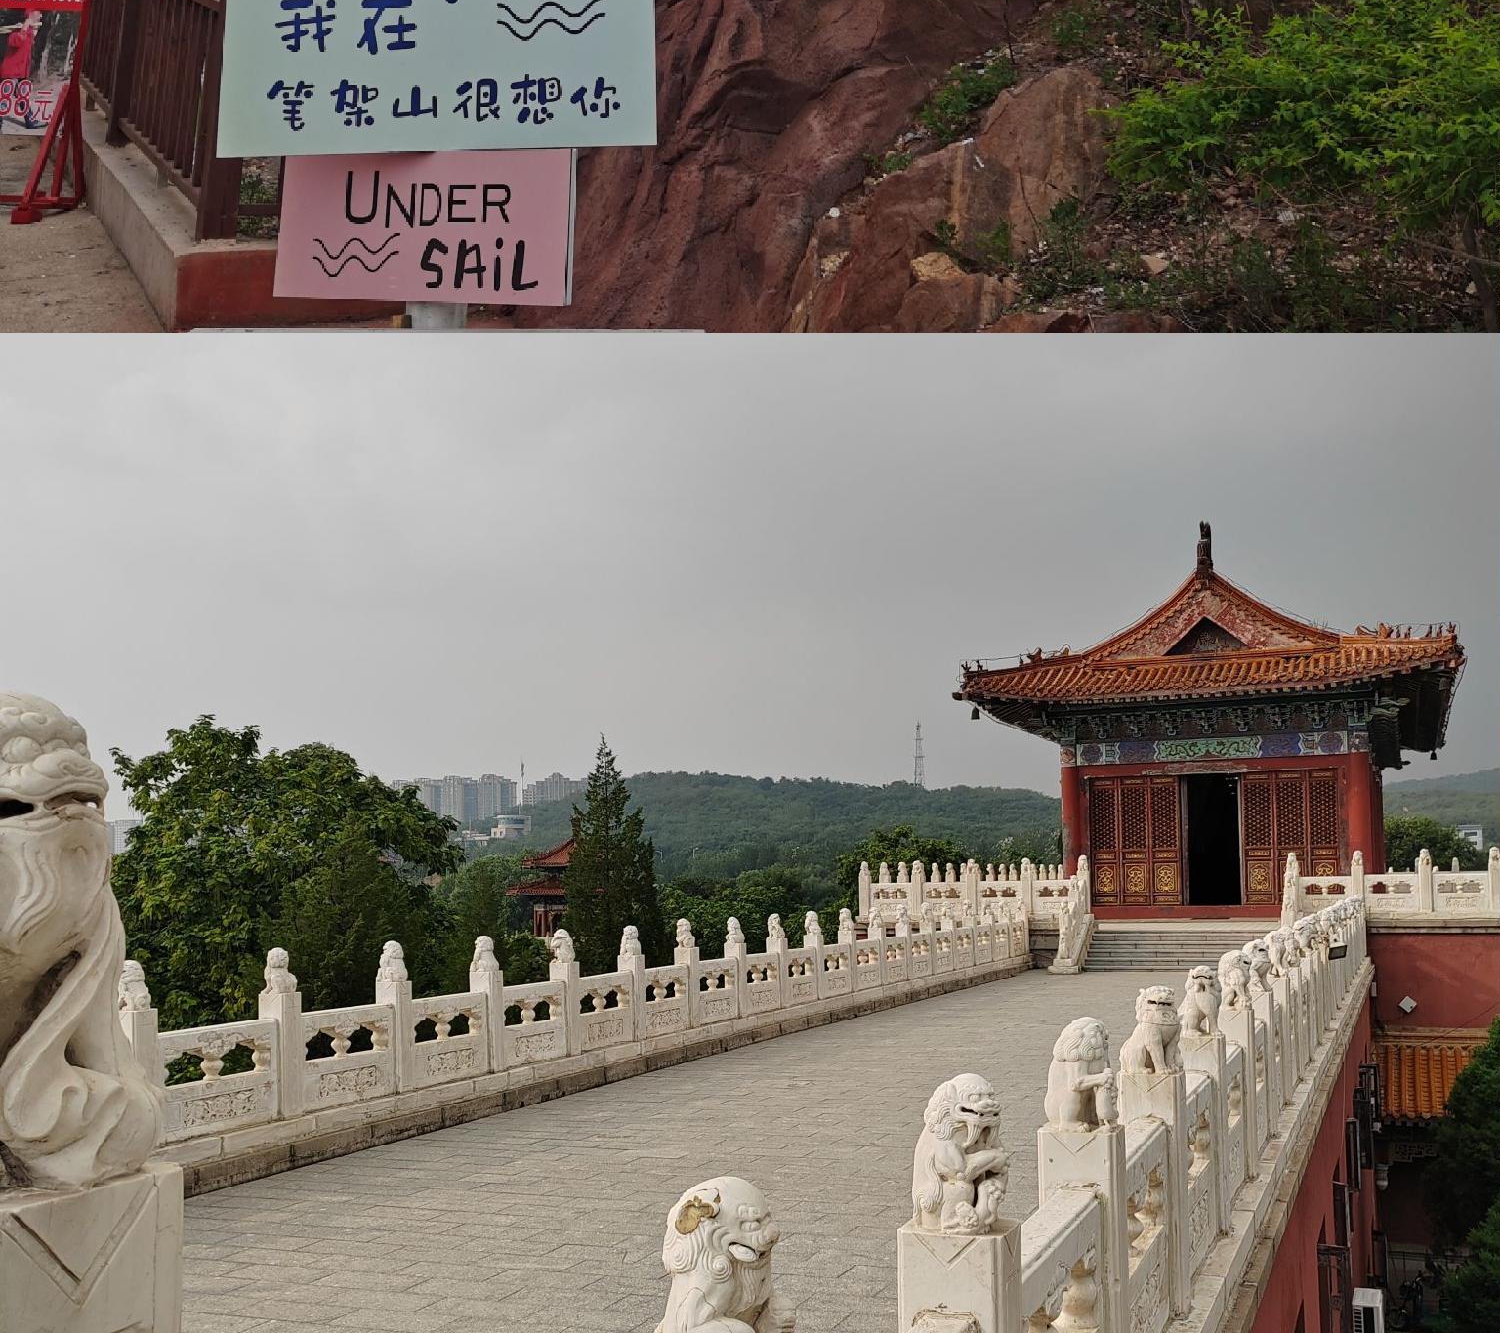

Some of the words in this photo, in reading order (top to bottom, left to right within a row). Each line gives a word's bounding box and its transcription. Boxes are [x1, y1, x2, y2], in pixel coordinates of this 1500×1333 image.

[267, 73, 621, 131] 笔架山很想你
